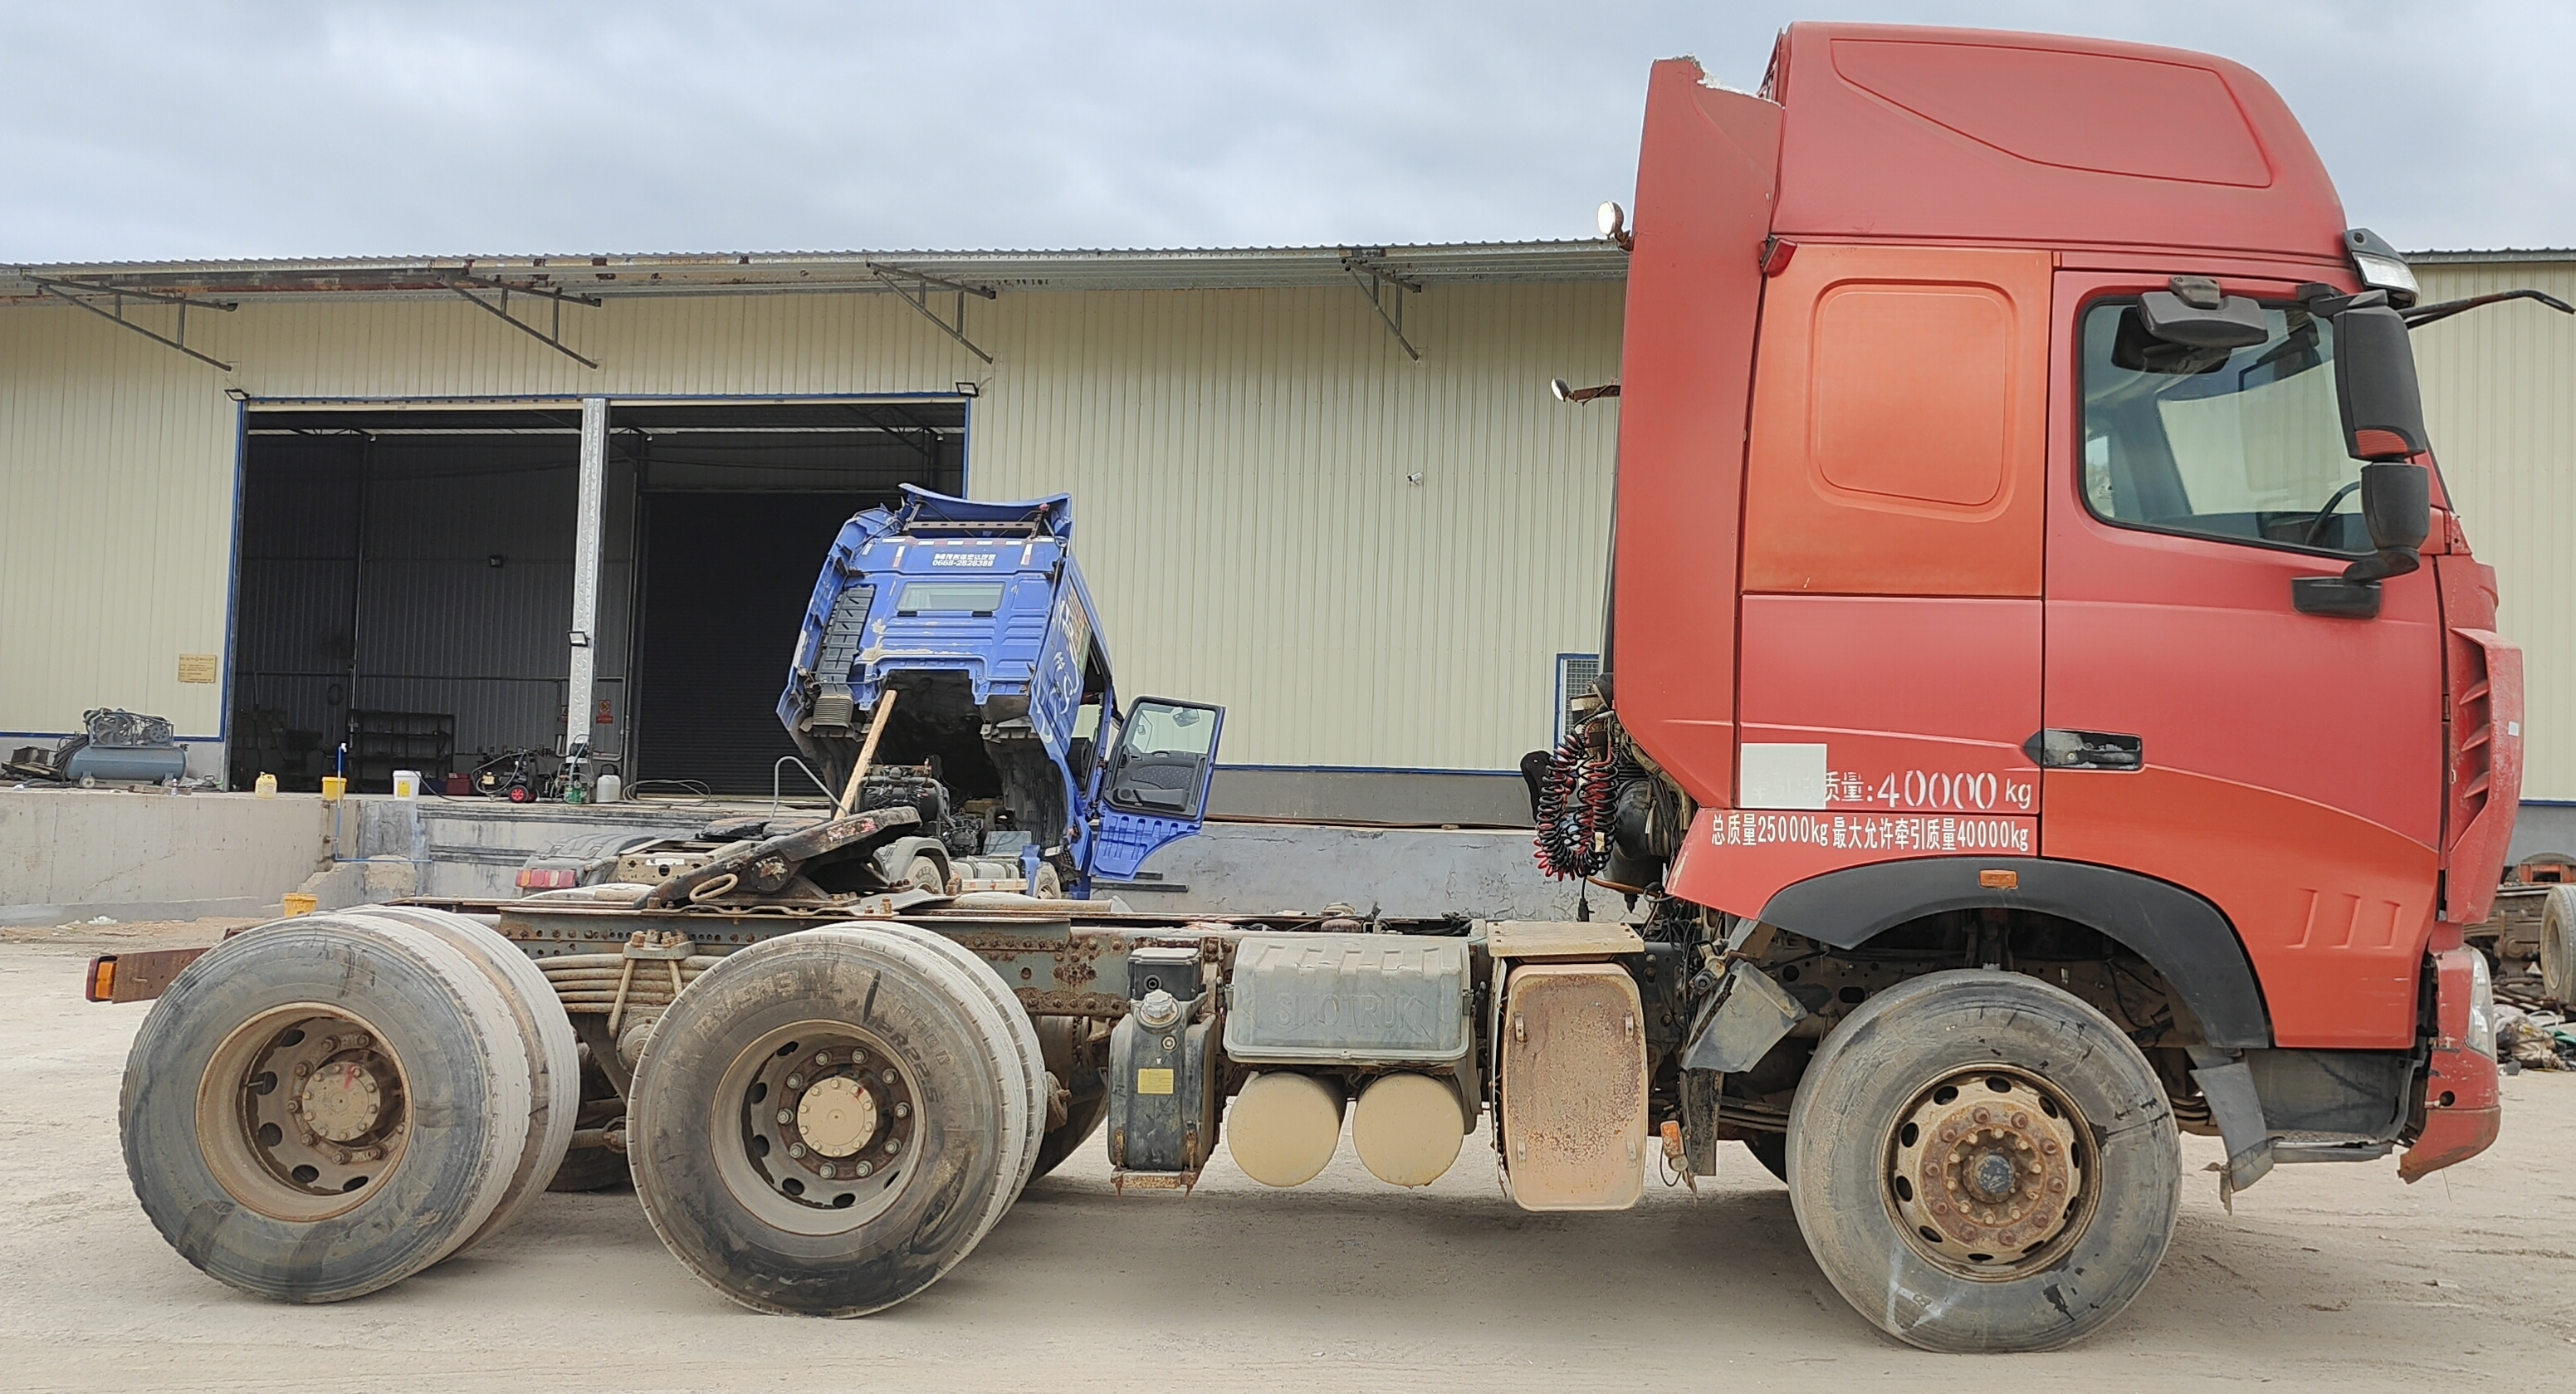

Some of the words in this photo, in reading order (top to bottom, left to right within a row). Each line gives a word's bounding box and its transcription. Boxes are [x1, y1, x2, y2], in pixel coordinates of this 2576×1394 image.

[1711, 813, 1829, 847] 总质量25000kg
[1832, 816, 2029, 852] 最大允许牵引质量40000kg
[1276, 993, 1420, 1030] SINOTRUK
[866, 1015, 940, 1103] 12R22.5
